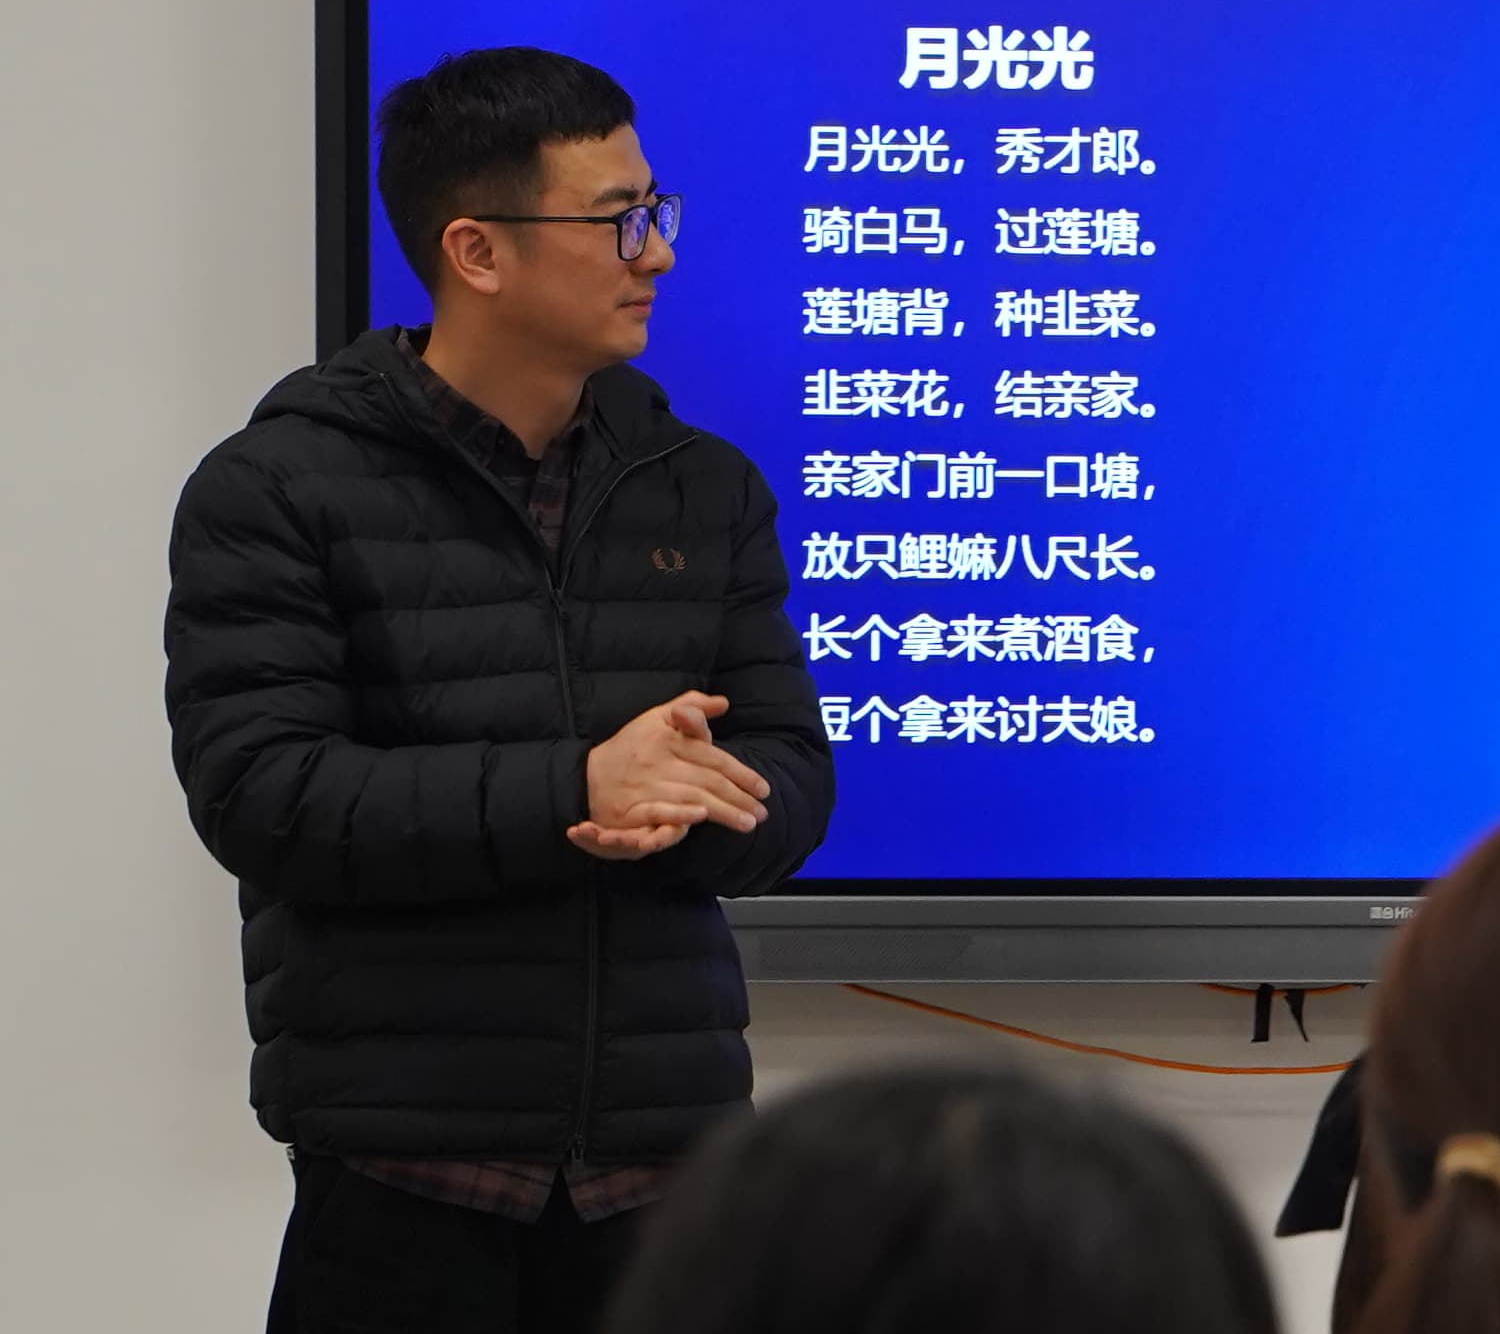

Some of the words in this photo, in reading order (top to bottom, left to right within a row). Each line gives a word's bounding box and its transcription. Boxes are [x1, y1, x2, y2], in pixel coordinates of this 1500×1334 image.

[898, 25, 1094, 90] 月光光
[804, 124, 1156, 176] 月光光，秀才郎。
[802, 206, 1156, 256] 骑白马，过莲塘。
[802, 287, 1156, 338] 莲塘背，种韭菜。
[802, 368, 1156, 419] 韭菜花，结亲家。
[802, 450, 1155, 501] 亲家门前一口塘，
[802, 612, 1154, 663] 长个拿来煮酒食，
